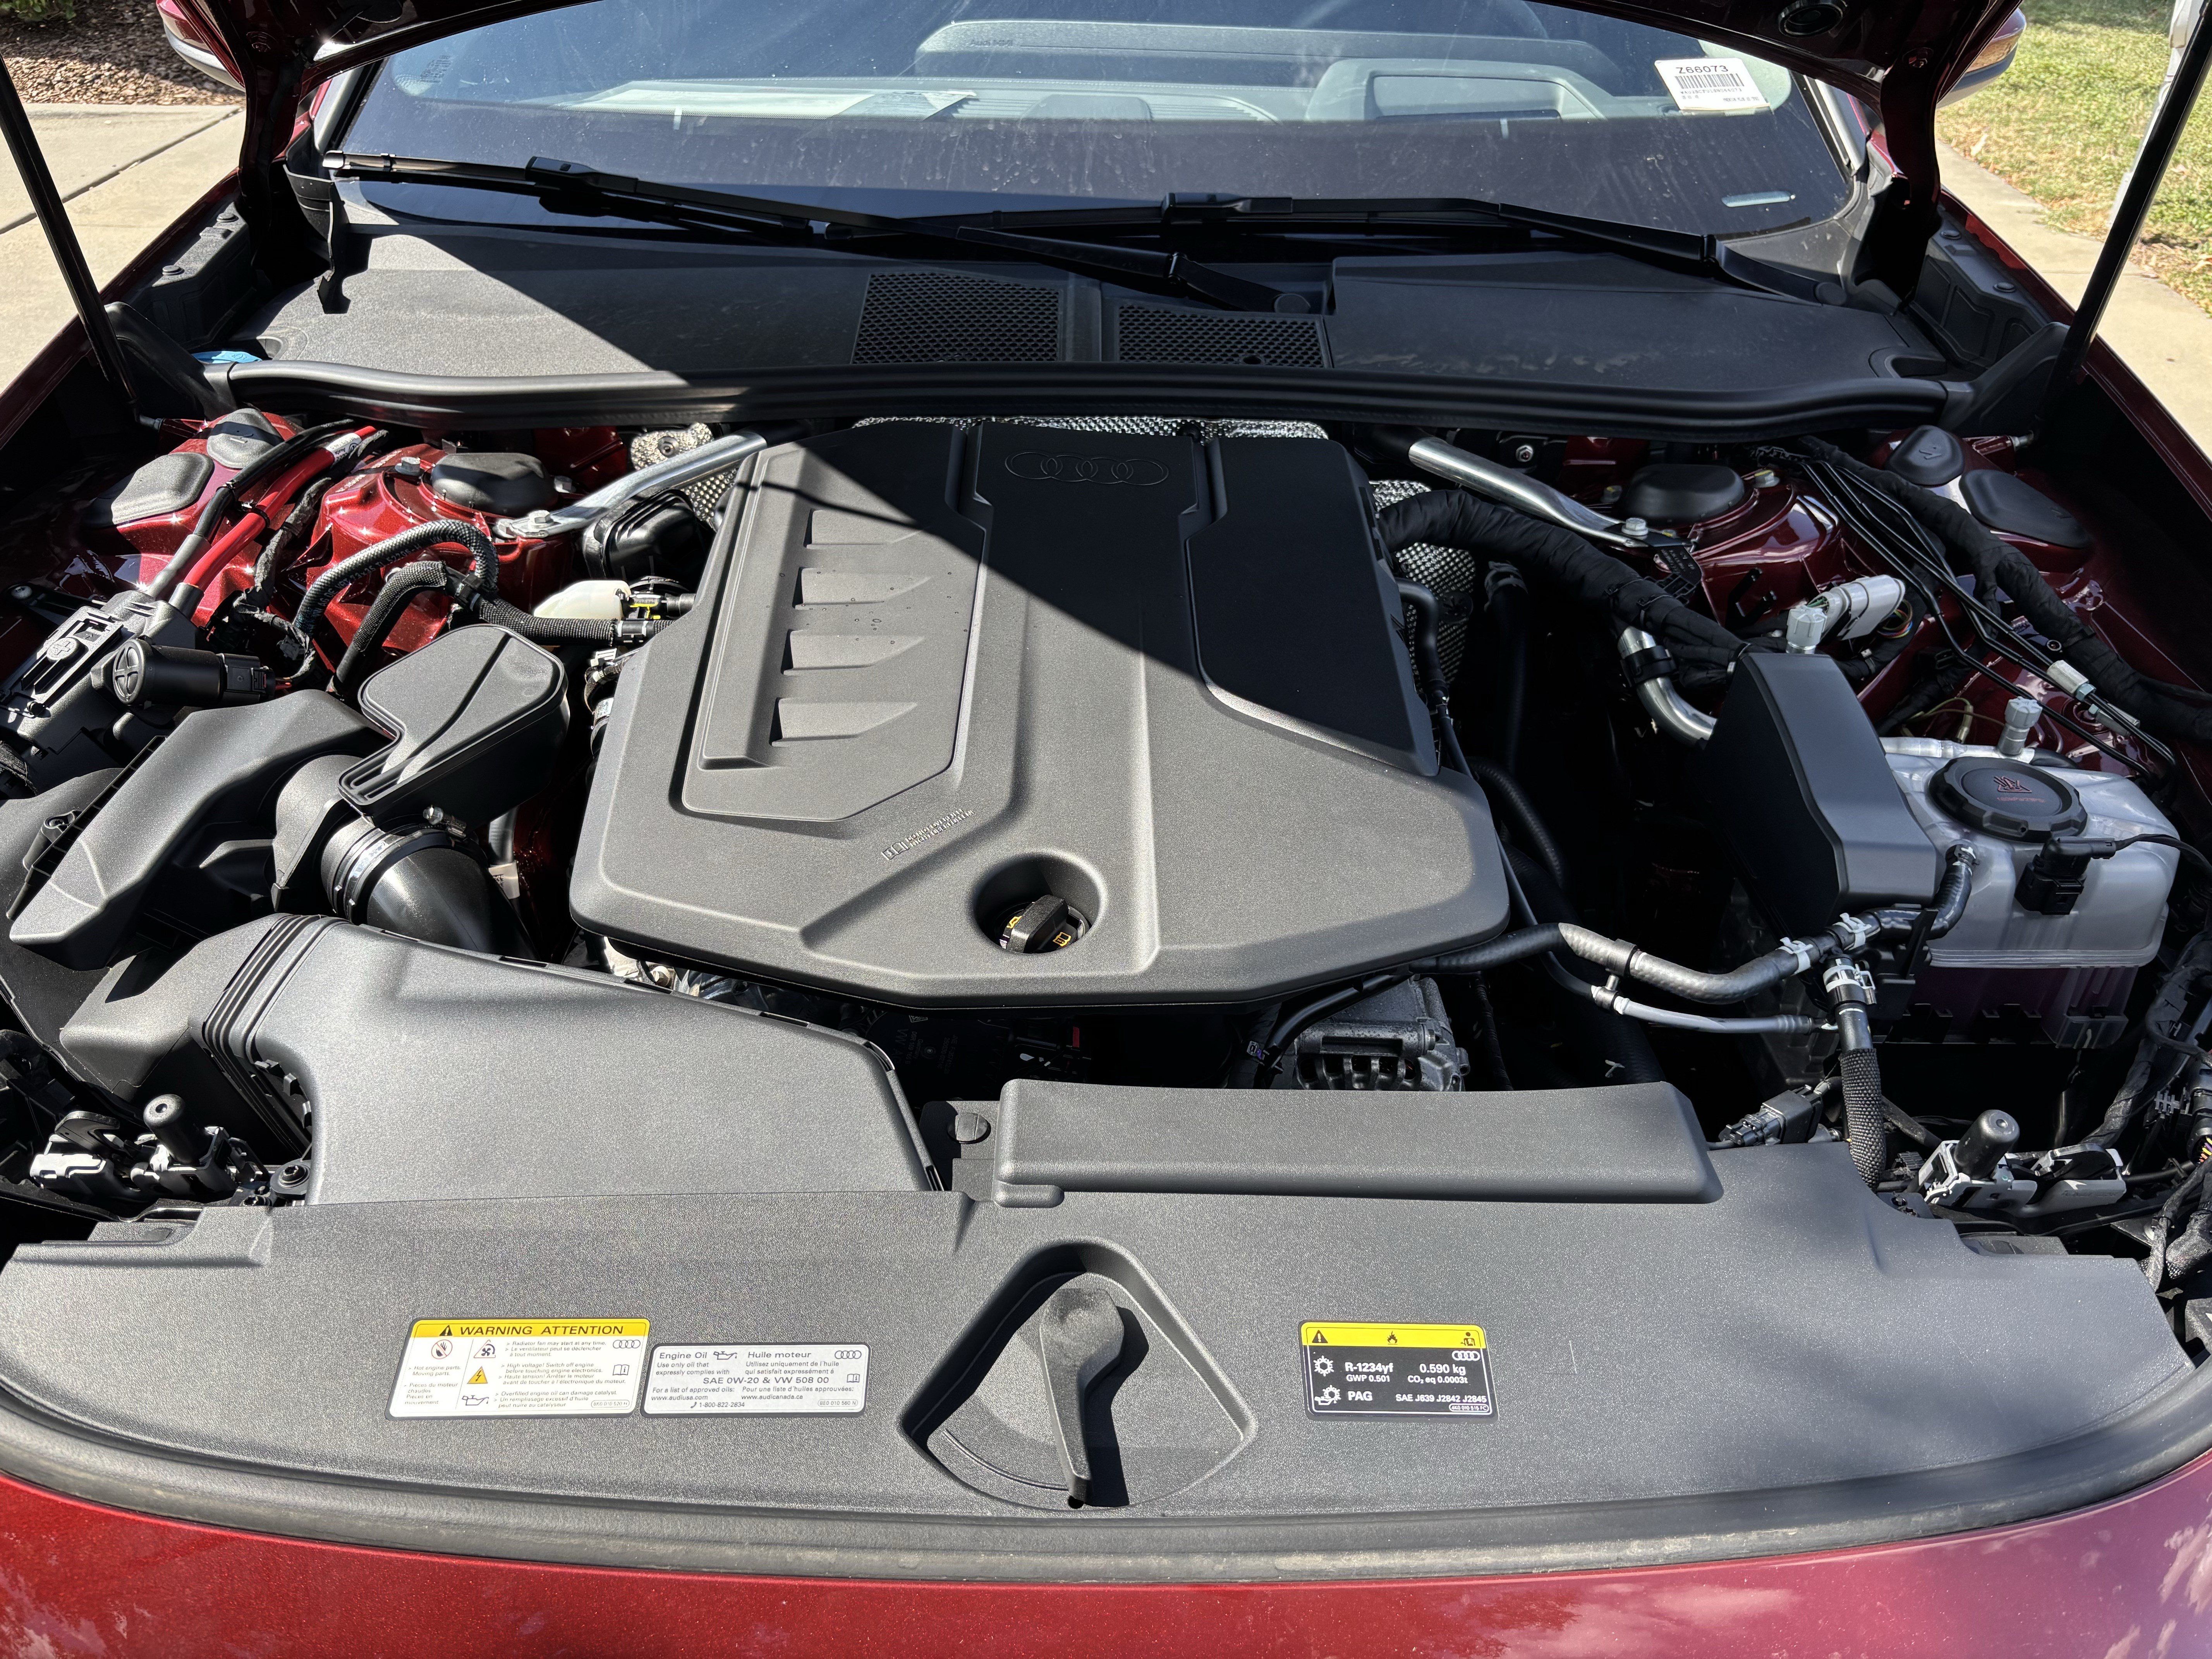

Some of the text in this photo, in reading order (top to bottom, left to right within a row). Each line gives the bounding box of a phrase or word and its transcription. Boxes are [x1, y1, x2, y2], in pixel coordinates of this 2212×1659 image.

[1676, 65, 1728, 74] Z66073
[461, 1326, 623, 1335] WARNING ATTENTION
[1345, 1362, 1393, 1374] R-1234yf
[1419, 1364, 1466, 1375] 0.590 kg
[1348, 1391, 1372, 1401] PAG
